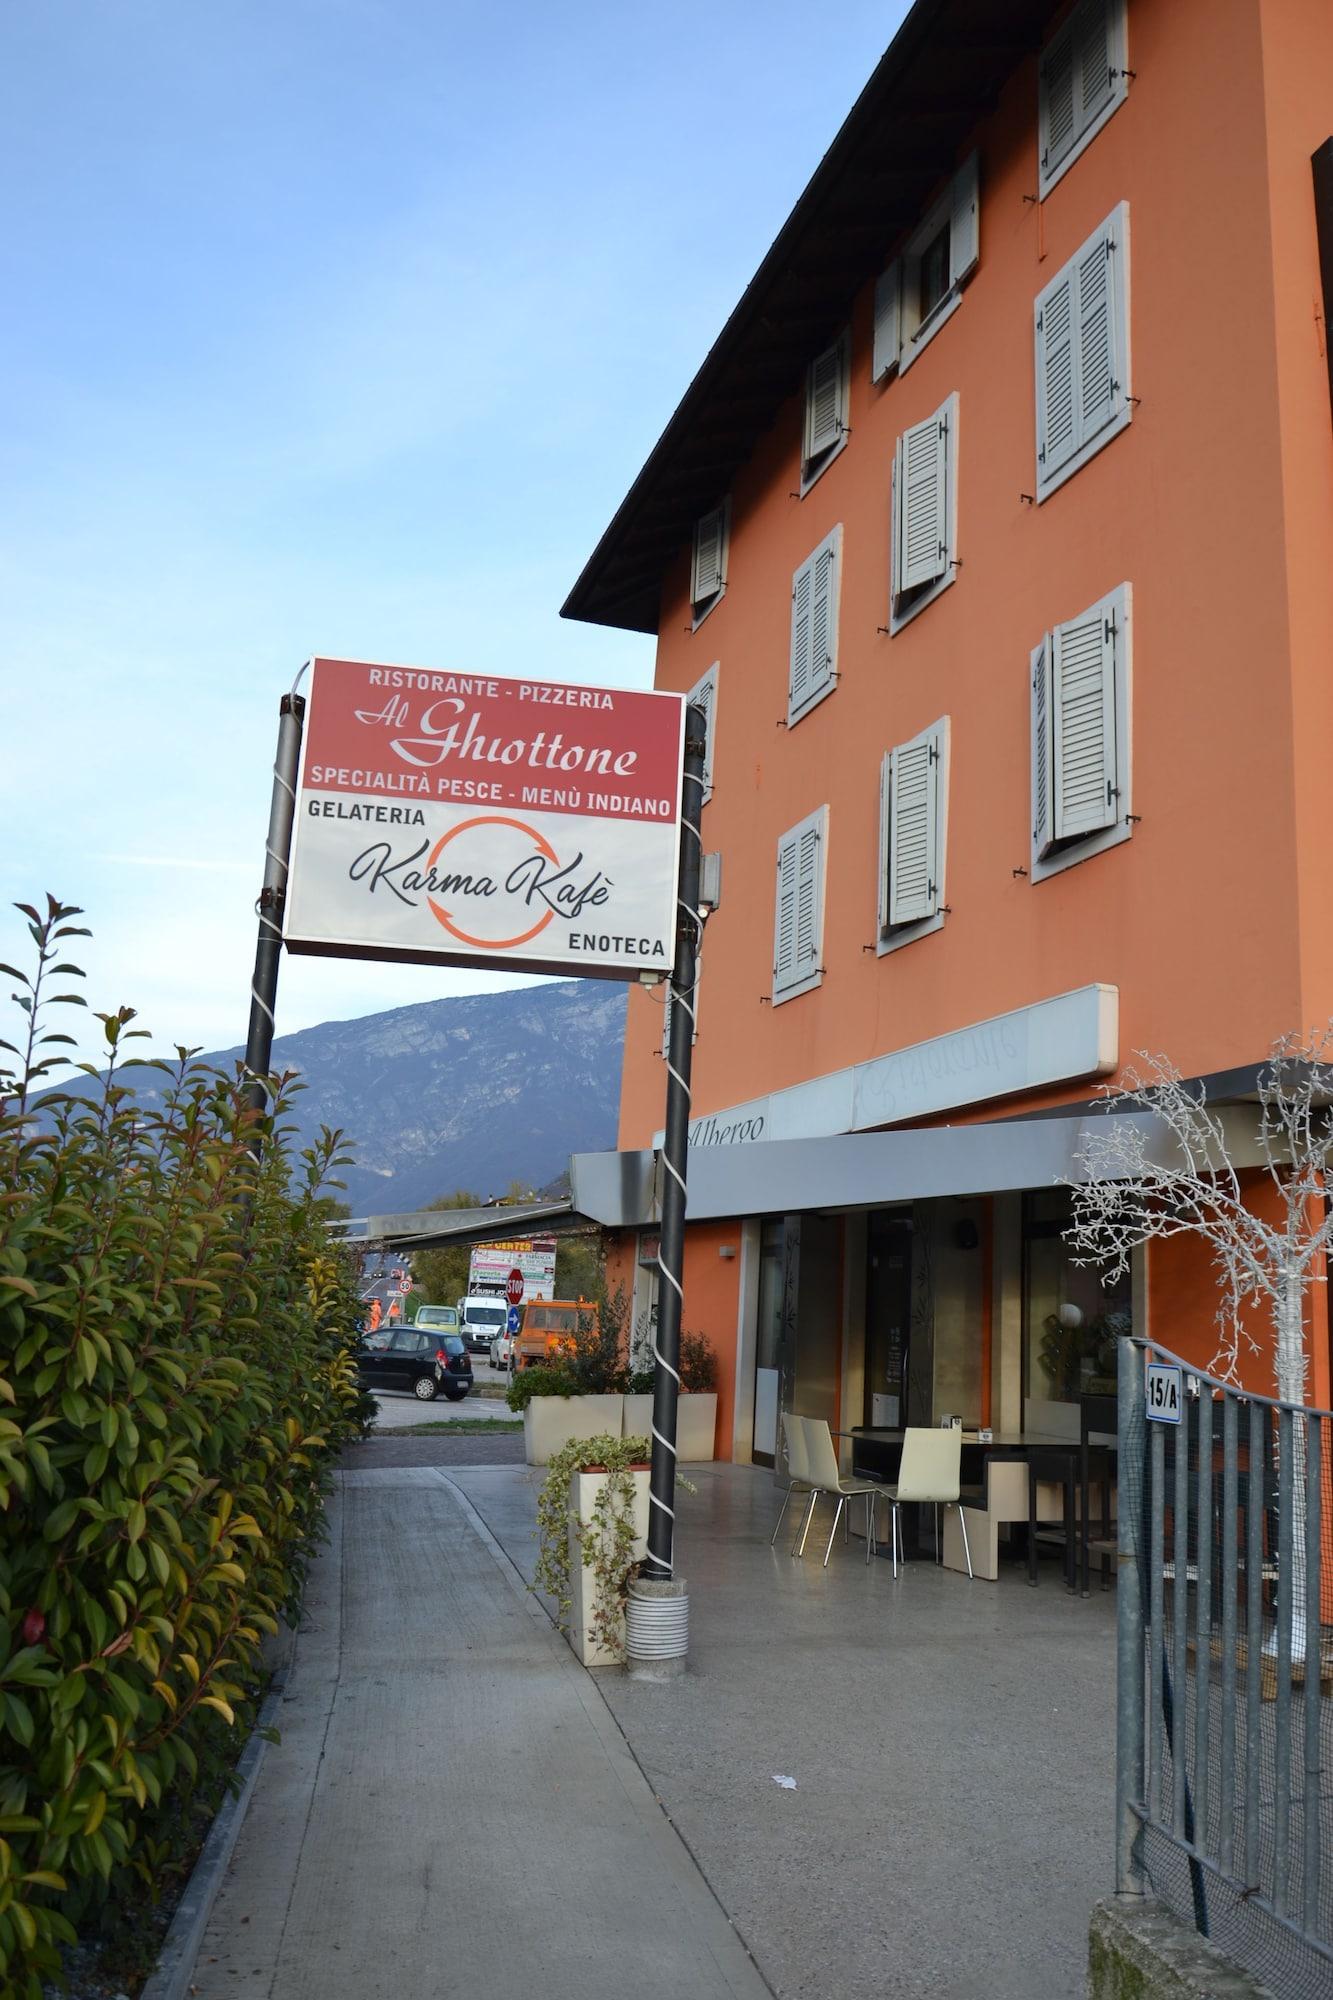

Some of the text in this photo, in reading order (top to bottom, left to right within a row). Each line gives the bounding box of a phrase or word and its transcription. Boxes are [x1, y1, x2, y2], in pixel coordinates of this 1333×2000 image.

[368, 668, 499, 698] RISTORANTE
[519, 685, 614, 711] PIZZERIA
[354, 693, 638, 776] Al Ghiottone
[310, 765, 431, 793] SPECIALITÀ
[437, 778, 502, 801] PESCE
[521, 785, 581, 809] MENÙ
[587, 793, 671, 817] INDIANO
[307, 799, 426, 826] GELATERIA
[349, 838, 615, 919] Karma Kafè
[568, 933, 665, 957] ENOTECA
[401, 1282, 409, 1290] 50
[508, 1279, 524, 1294] STOP
[1150, 1377, 1177, 1409] 15/A
